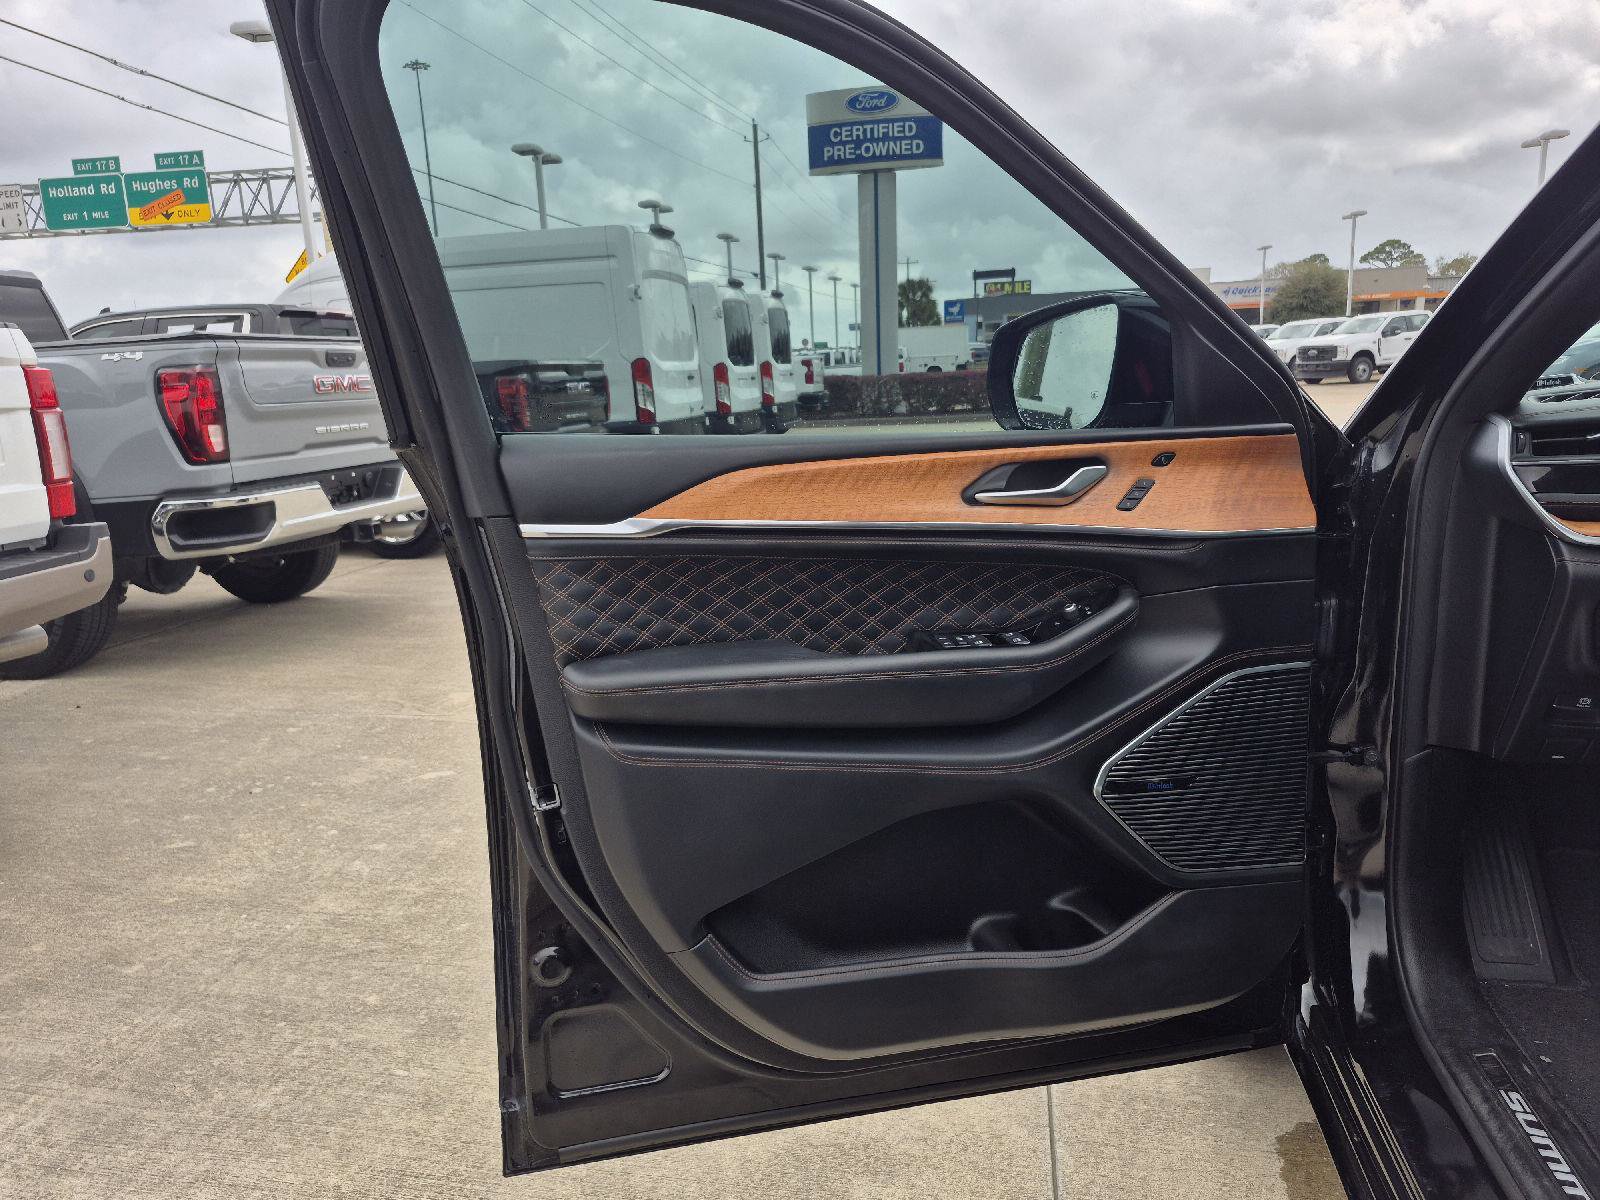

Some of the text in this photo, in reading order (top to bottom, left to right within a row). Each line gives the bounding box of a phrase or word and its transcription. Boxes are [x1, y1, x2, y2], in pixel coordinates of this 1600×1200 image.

[856, 94, 888, 109] Ford
[829, 121, 917, 143] CERTIFIED
[823, 139, 925, 161] PRE-OWNED
[76, 159, 116, 171] EXIT 17 B
[159, 153, 200, 166] EXIT 17 A
[48, 182, 116, 198] Holland Rd
[132, 176, 199, 193] Hughes Rd
[63, 211, 110, 221] EXIT 1 MILE
[177, 209, 200, 218] ONLY
[314, 375, 371, 394] GMC
[315, 423, 369, 434] SIERRA
